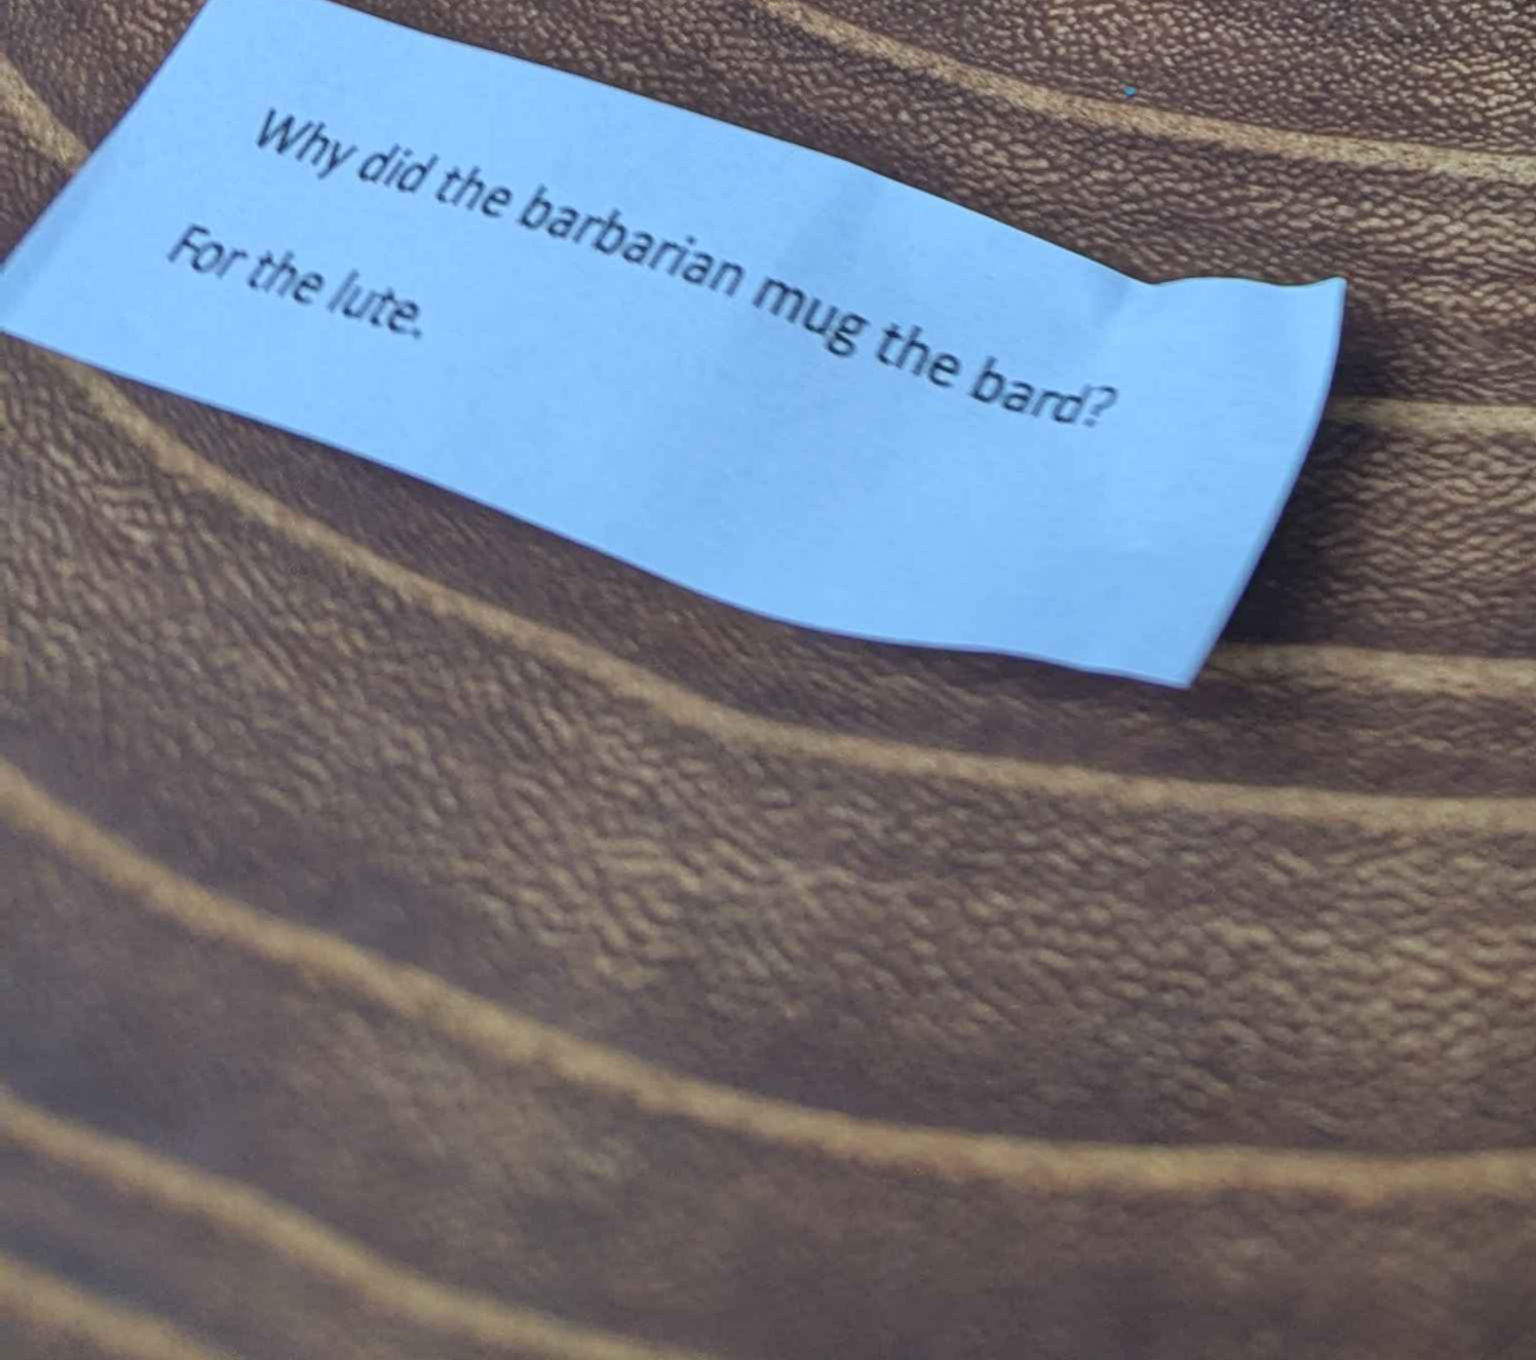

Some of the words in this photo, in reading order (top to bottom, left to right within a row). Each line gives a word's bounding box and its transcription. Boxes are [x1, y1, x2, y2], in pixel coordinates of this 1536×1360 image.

[166, 223, 247, 281] For
[247, 250, 324, 305] the
[327, 269, 423, 339] lute.
[255, 107, 357, 179] Why
[357, 143, 439, 195] did
[435, 164, 512, 219] the
[515, 184, 744, 297] barbarian
[751, 275, 868, 357] mug
[875, 317, 961, 388] the
[968, 356, 1118, 427] bard?
